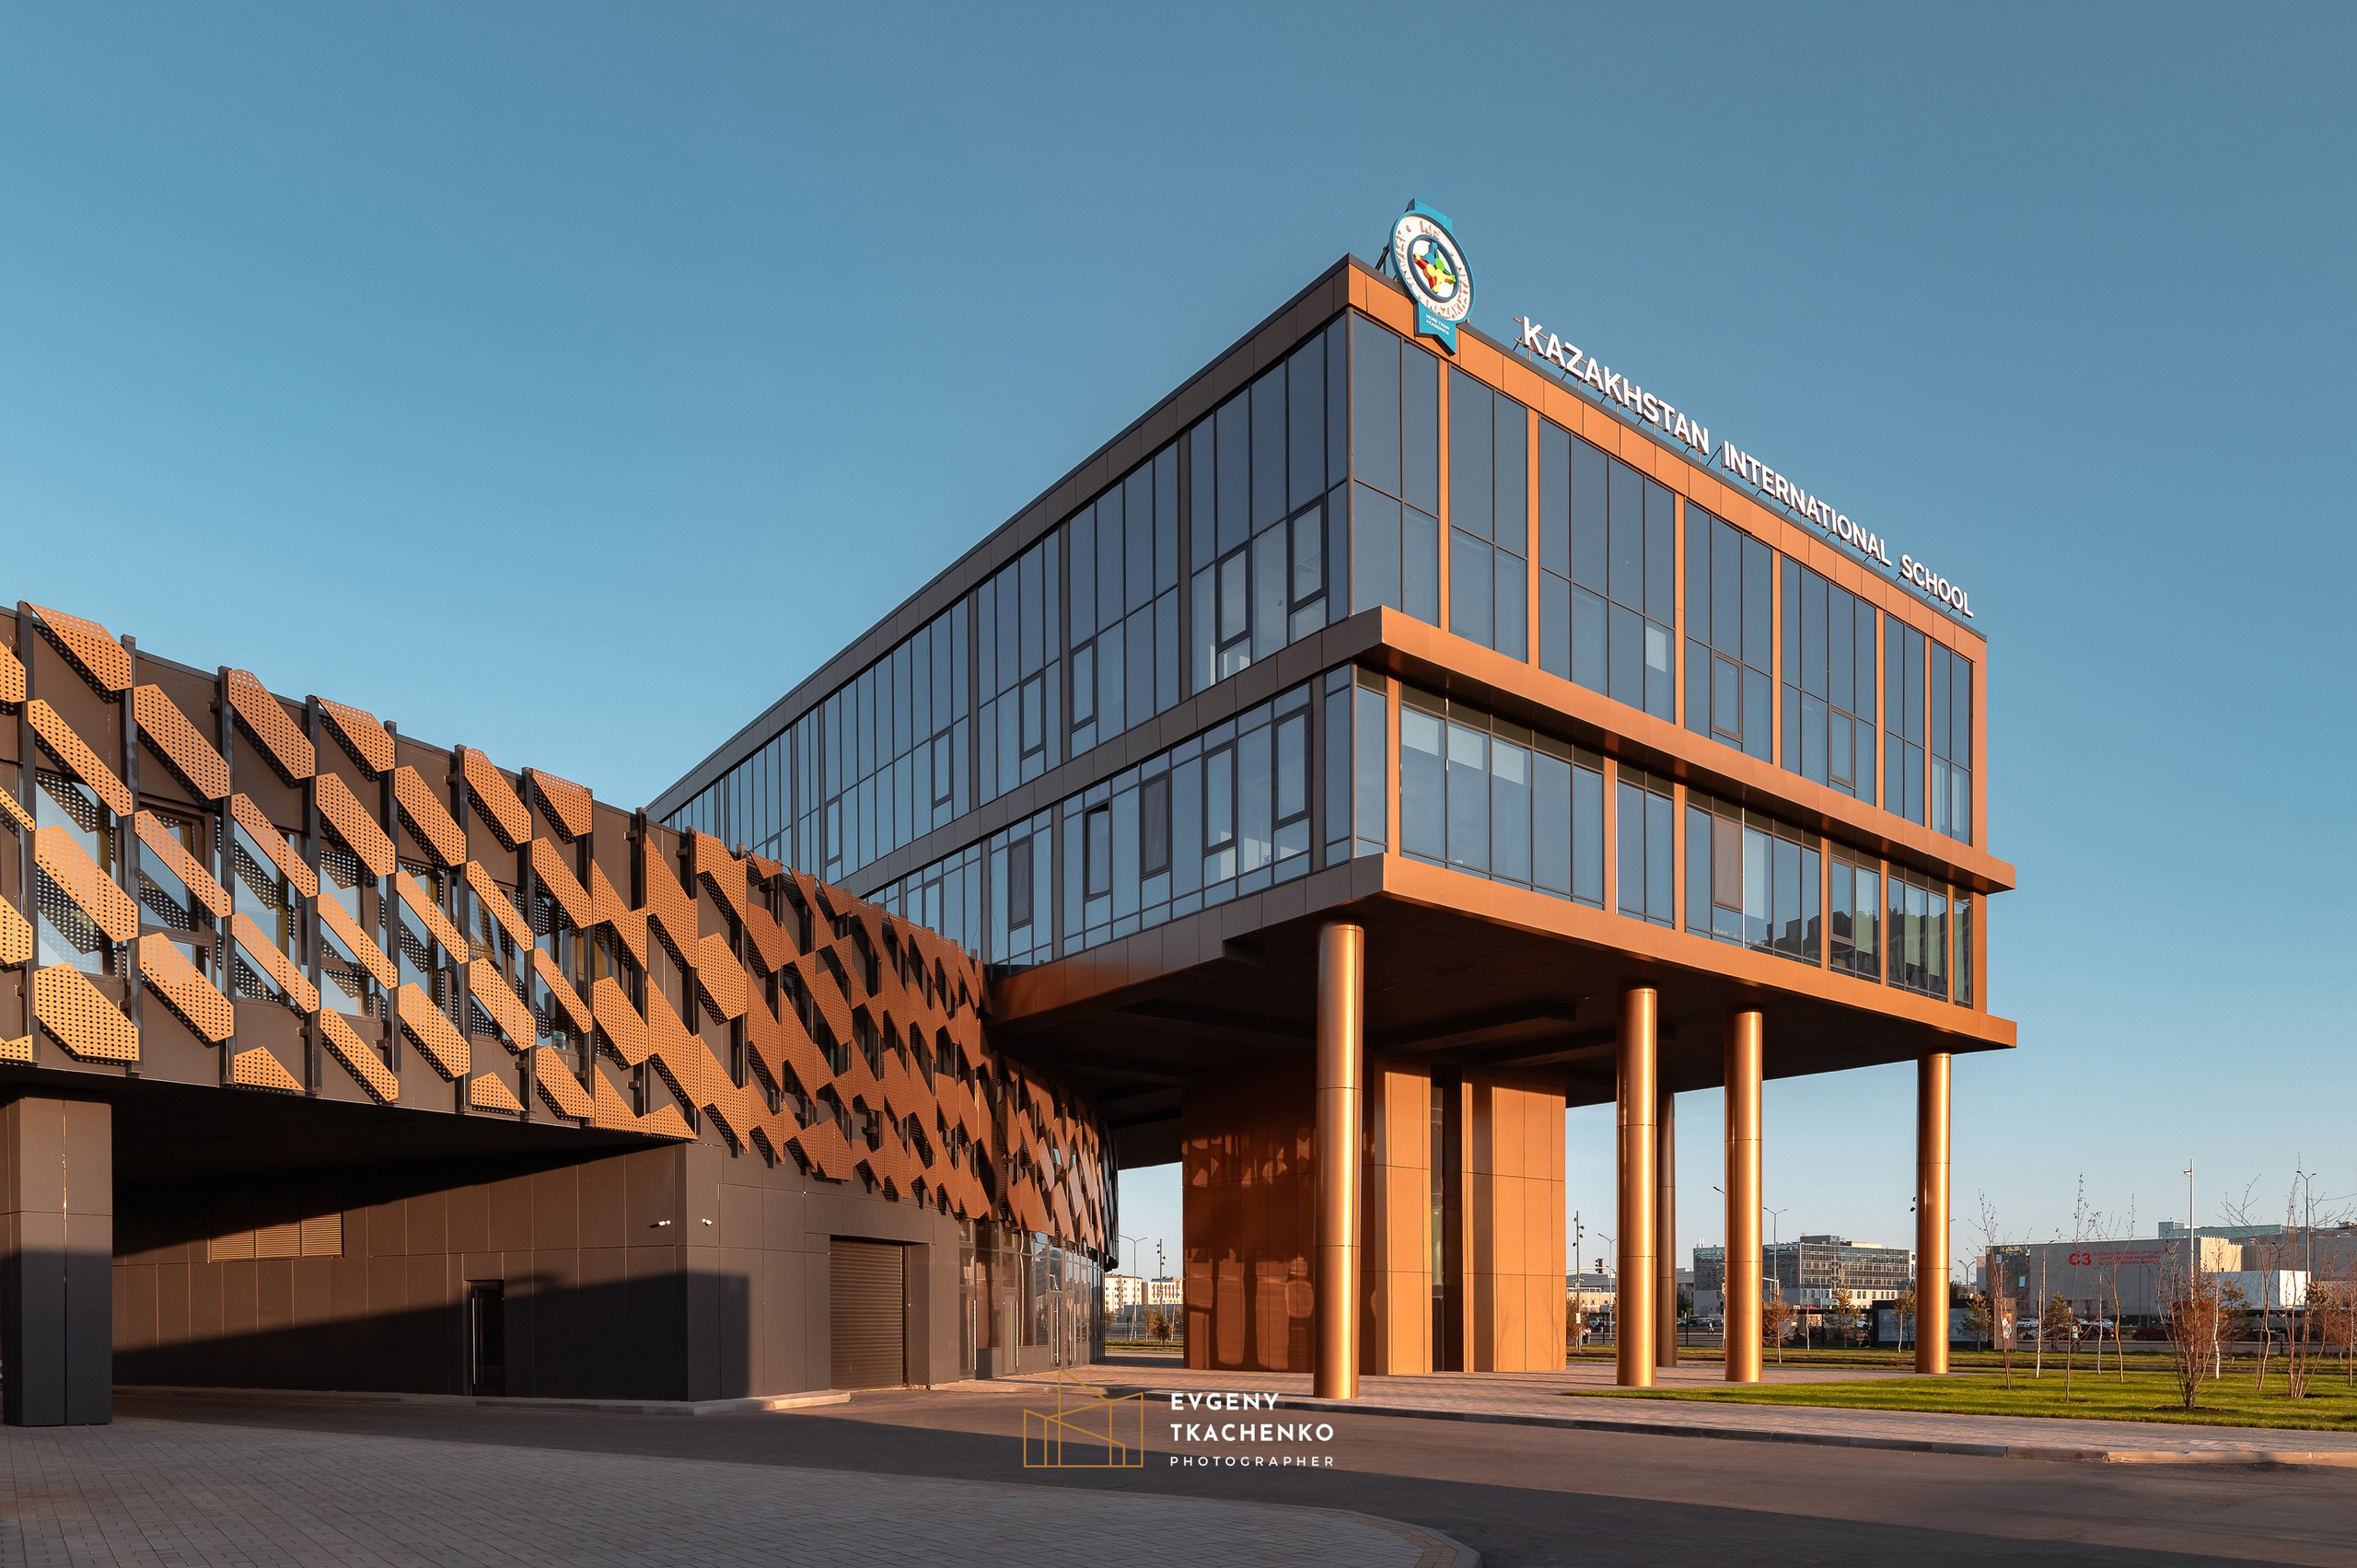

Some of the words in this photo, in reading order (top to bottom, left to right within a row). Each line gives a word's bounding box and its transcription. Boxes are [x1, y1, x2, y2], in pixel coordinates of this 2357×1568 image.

[1522, 315, 1710, 456] KAZAKHSTAN
[1721, 440, 1892, 566] INTERNATIONAL
[1899, 553, 1974, 618] SCHOOL
